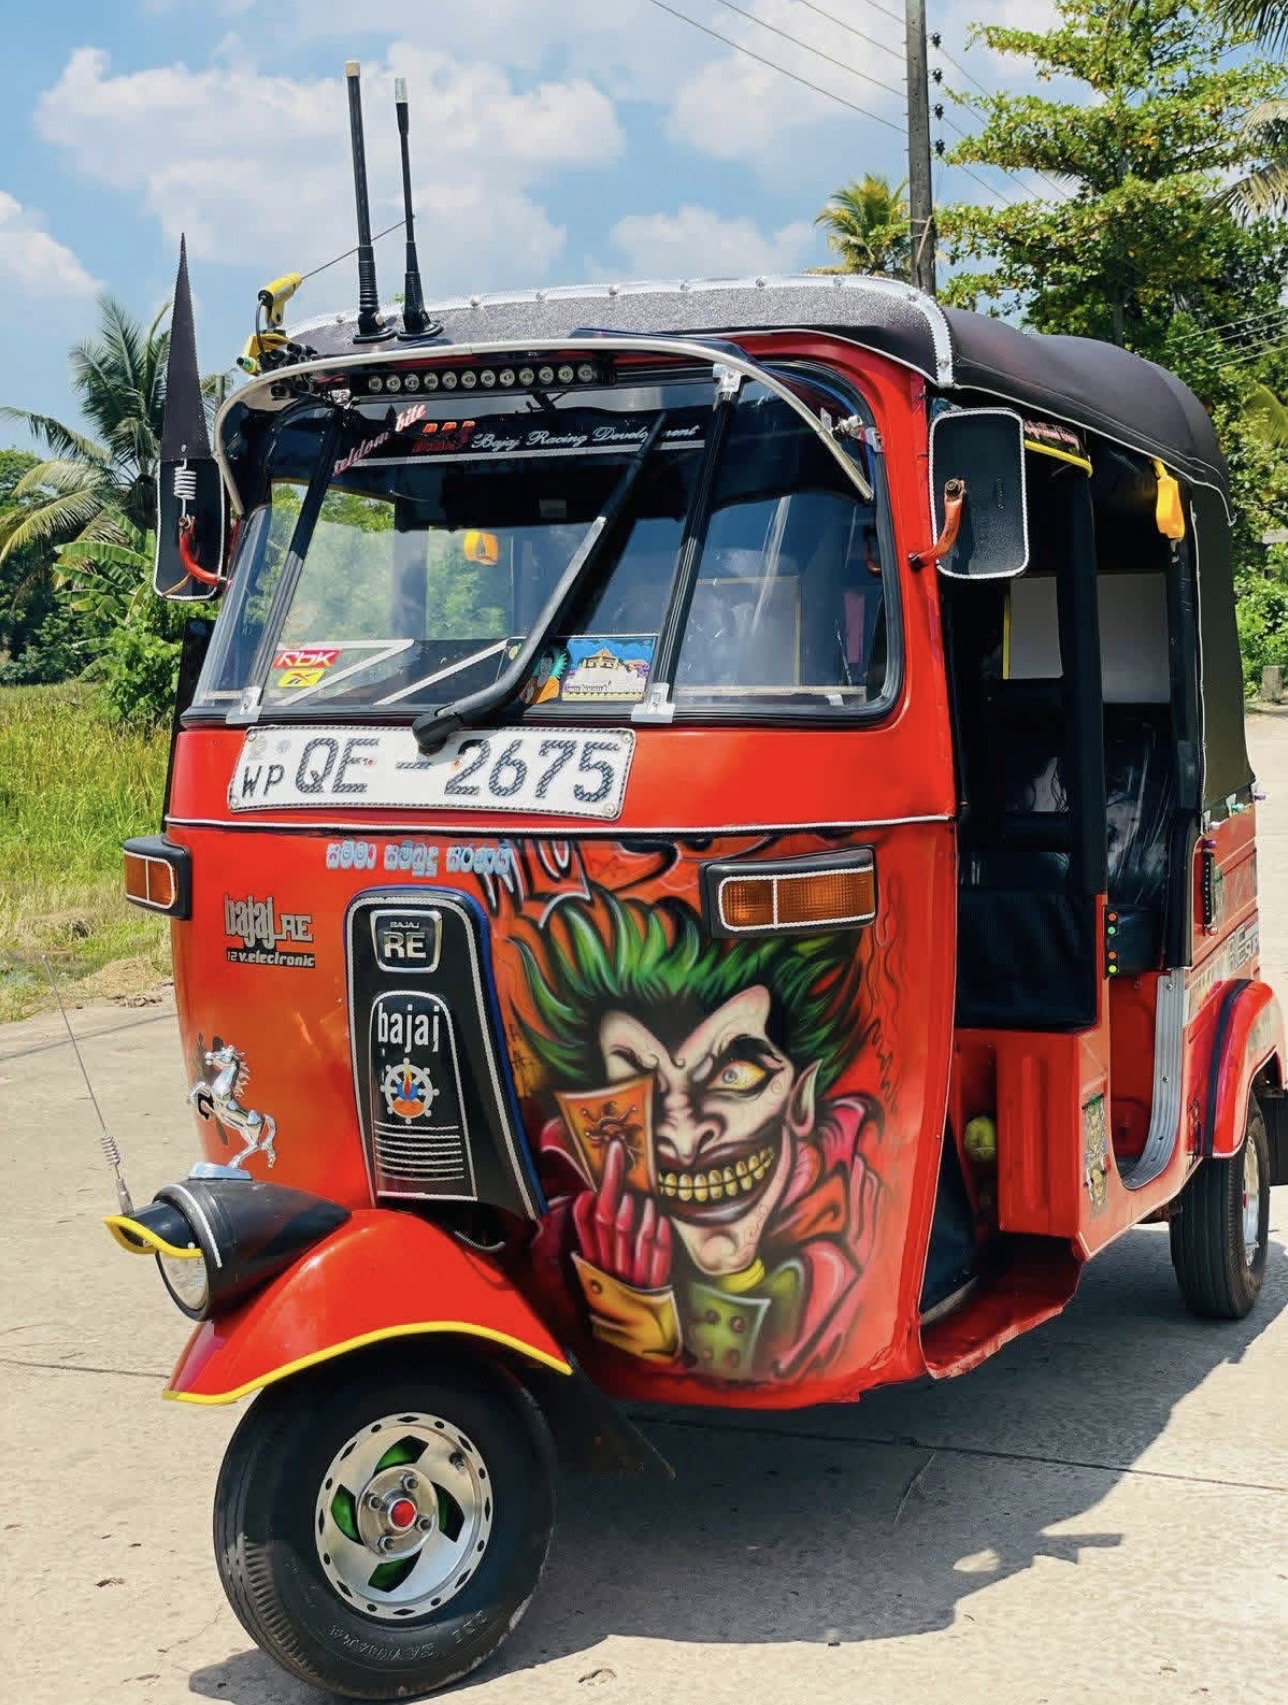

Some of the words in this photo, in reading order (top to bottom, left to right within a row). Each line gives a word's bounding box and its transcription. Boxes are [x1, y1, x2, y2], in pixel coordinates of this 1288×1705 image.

[471, 433, 520, 452] Bajaj
[526, 430, 588, 447] Racing
[242, 764, 285, 798] WP
[295, 736, 382, 794] QE
[444, 738, 621, 802] 2675
[390, 921, 420, 929] BAJAJ
[383, 931, 427, 959] RE
[377, 1002, 440, 1053] bajaj
